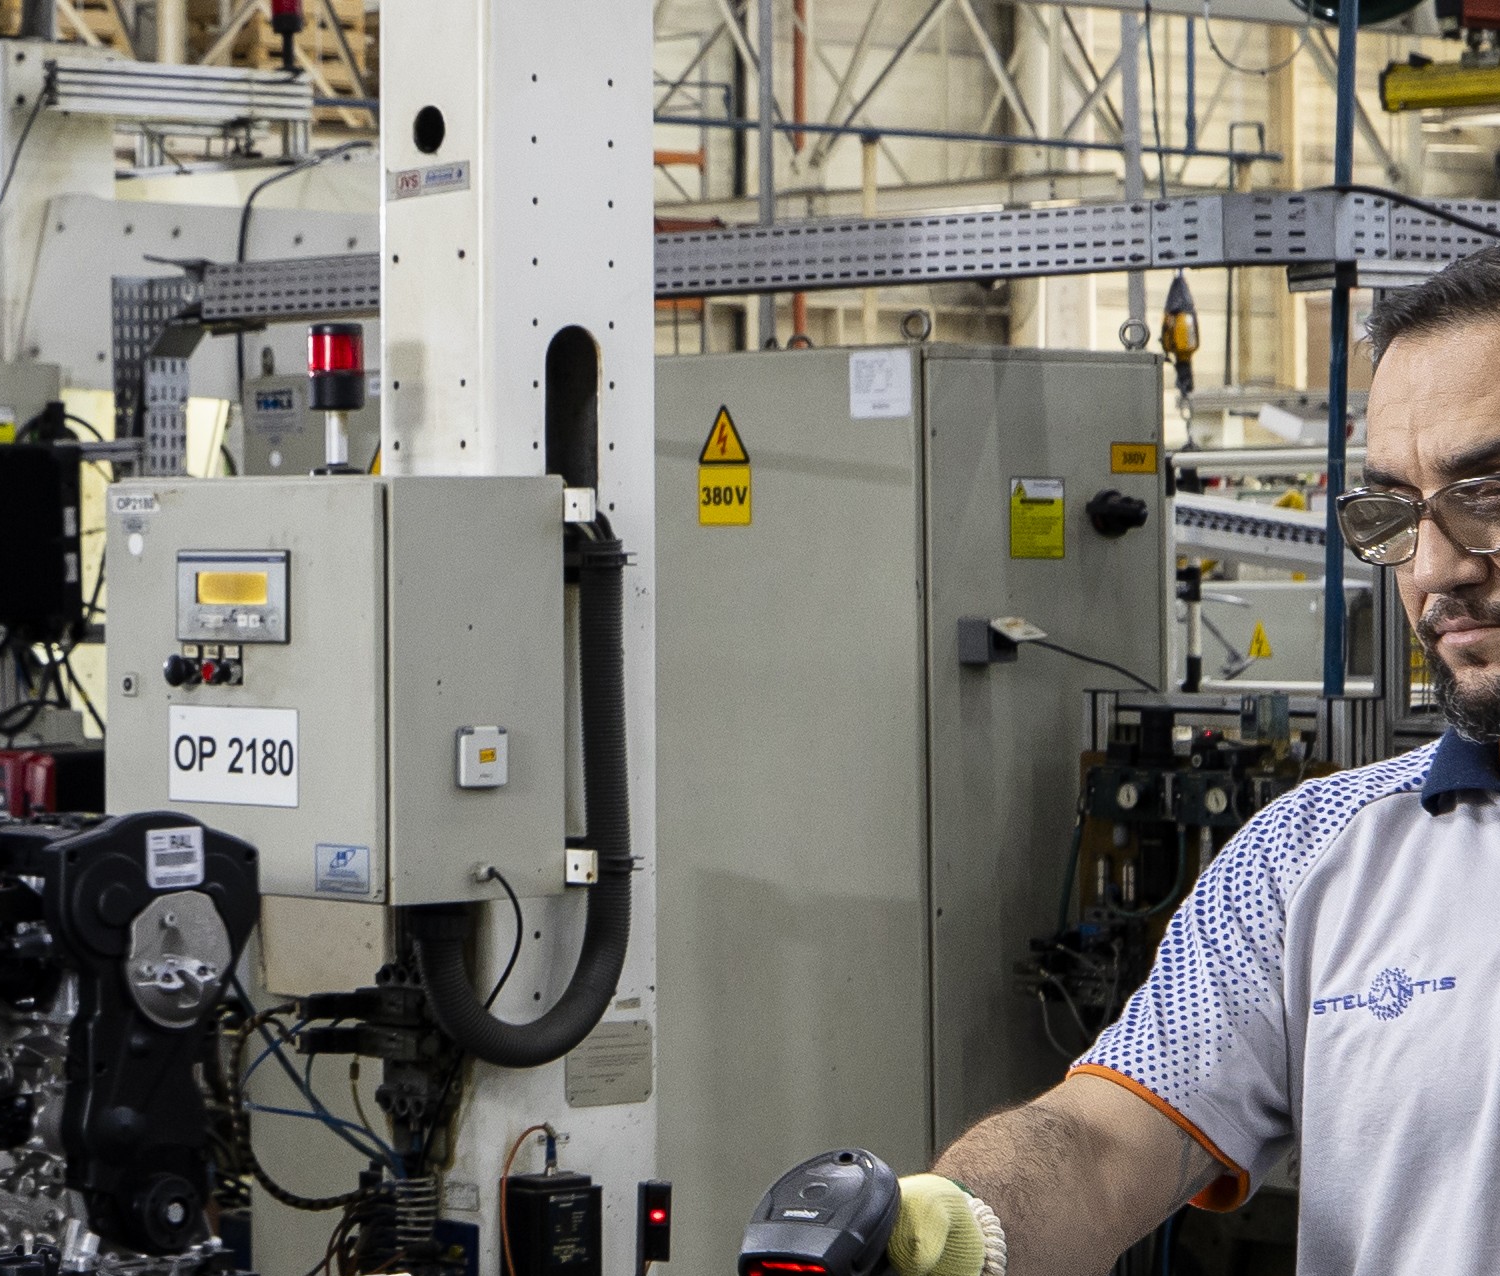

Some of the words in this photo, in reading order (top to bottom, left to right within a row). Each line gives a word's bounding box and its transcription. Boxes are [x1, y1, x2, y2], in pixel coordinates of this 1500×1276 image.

[701, 486, 748, 506] 380V
[174, 734, 217, 772] OP
[227, 737, 295, 776] 2180
[1313, 976, 1457, 1016] STELLANTIS
